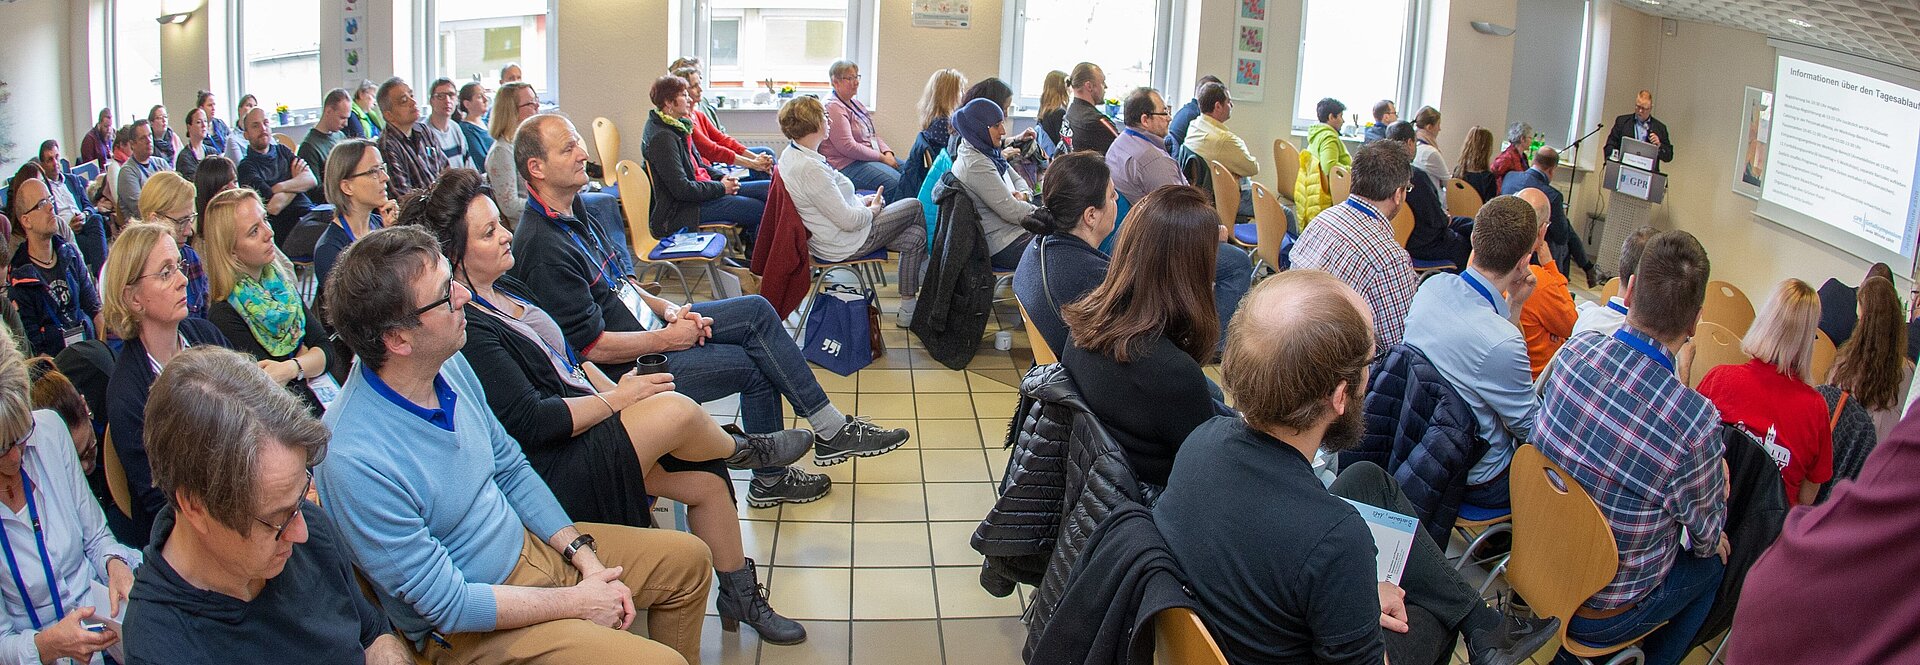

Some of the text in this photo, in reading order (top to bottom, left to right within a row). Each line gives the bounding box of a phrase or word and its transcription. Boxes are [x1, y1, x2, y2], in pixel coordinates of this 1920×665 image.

[1790, 68, 1920, 110] Informationen über den Tagesablauf
[1630, 176, 1648, 189] GPR
